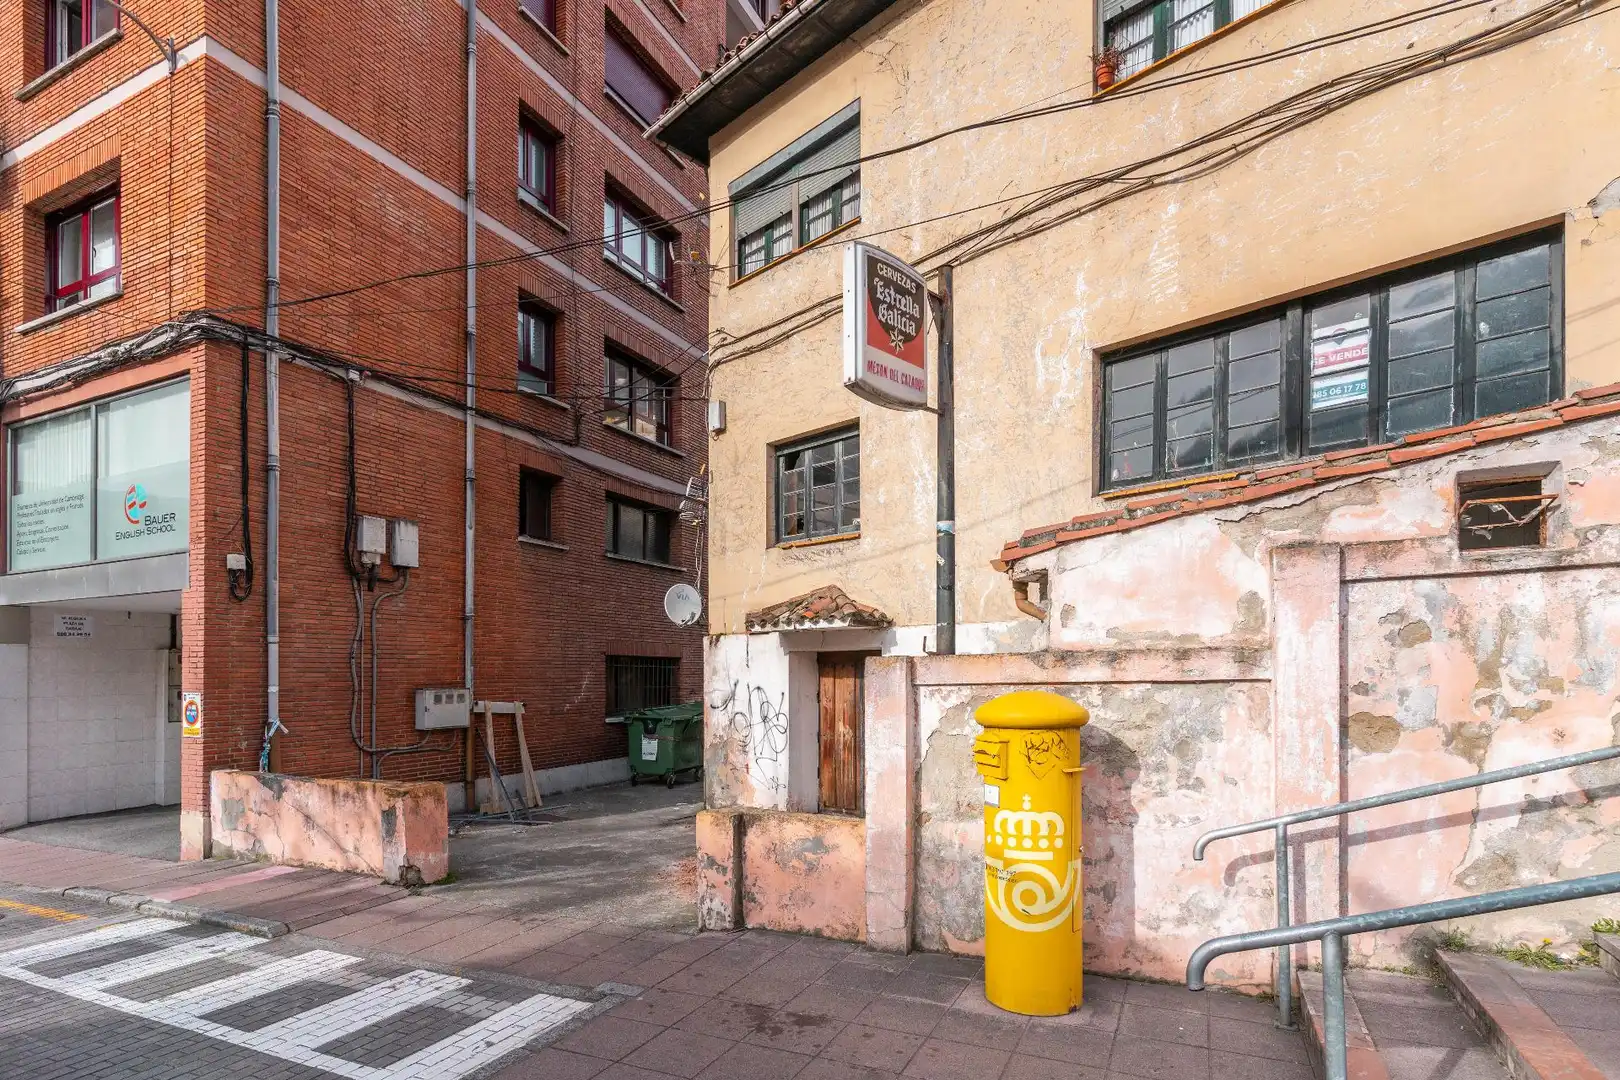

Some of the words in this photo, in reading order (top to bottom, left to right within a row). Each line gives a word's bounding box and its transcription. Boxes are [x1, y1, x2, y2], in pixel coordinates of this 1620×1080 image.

[877, 263, 917, 294] CERVEZAS
[874, 277, 920, 318] Estrella
[878, 303, 916, 336] Galicia
[1329, 347, 1368, 361] VENDE
[1330, 387, 1341, 395] 06
[1344, 385, 1352, 393] 17
[1355, 382, 1366, 391] 78
[145, 513, 176, 526] BAUER
[115, 529, 145, 540] ENGLISH
[146, 524, 176, 535] SCHOOL
